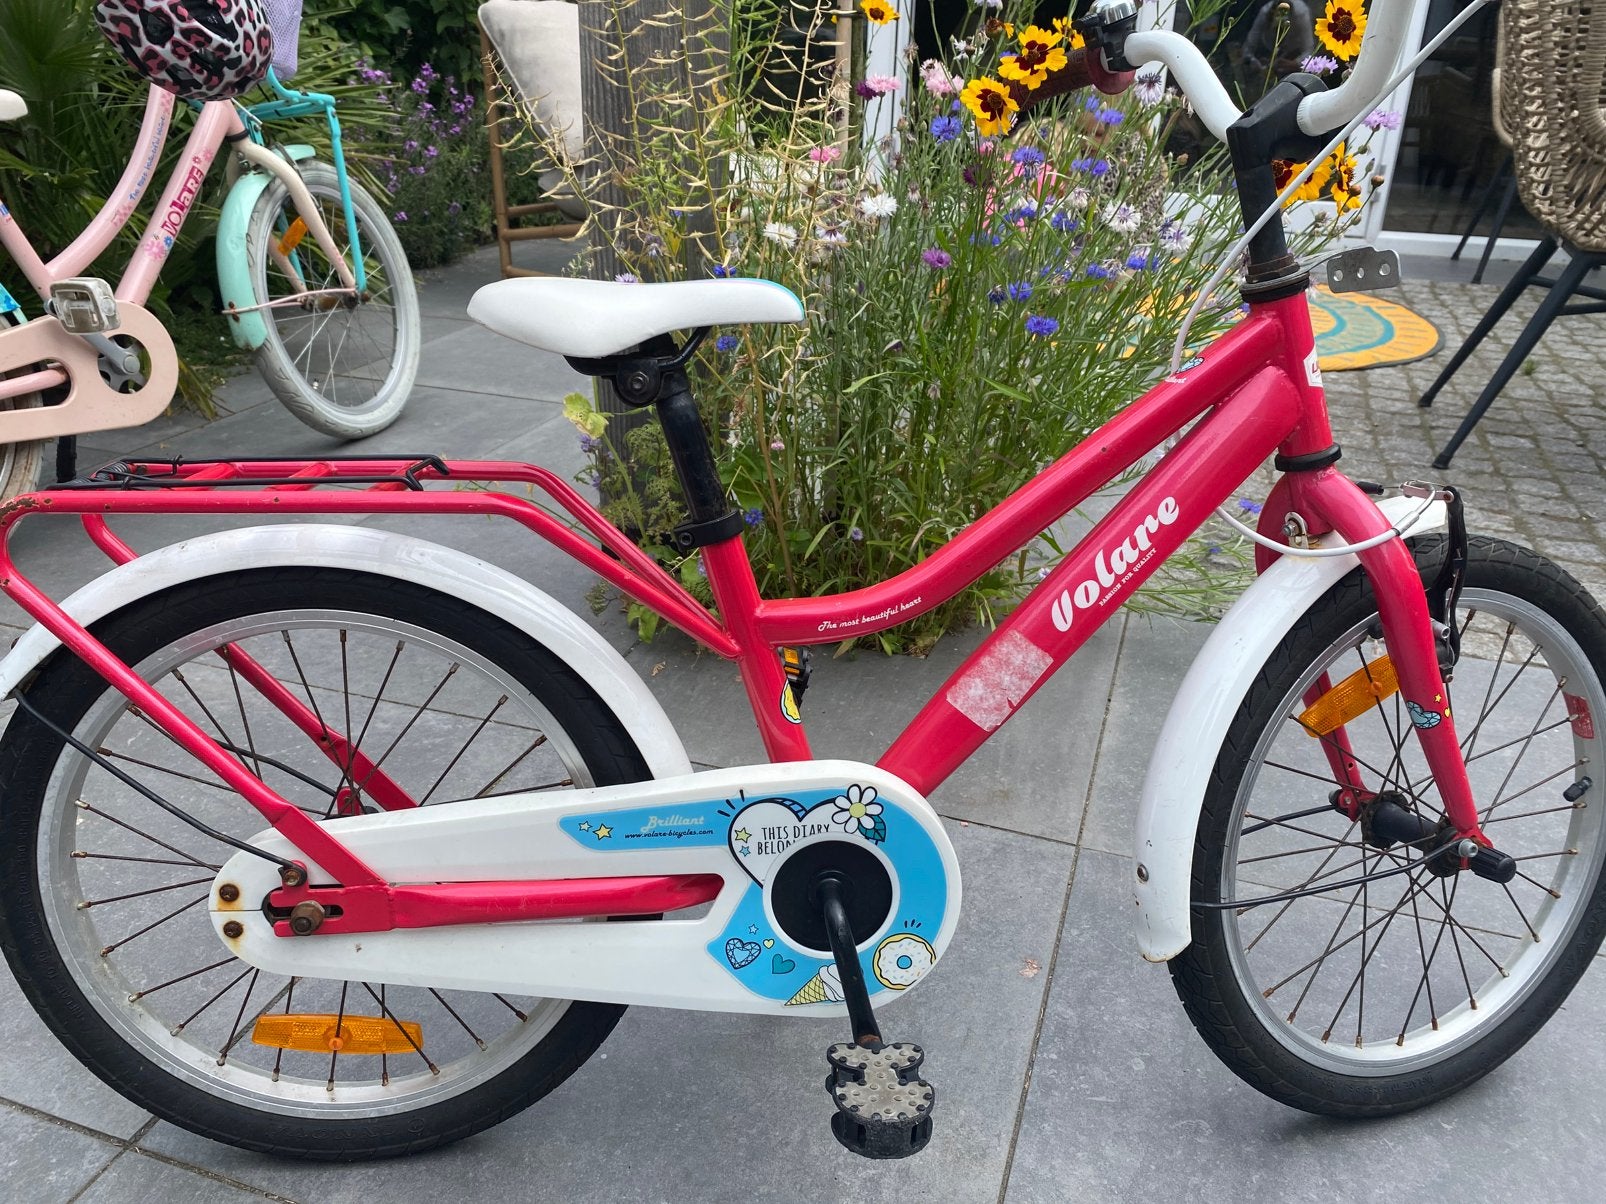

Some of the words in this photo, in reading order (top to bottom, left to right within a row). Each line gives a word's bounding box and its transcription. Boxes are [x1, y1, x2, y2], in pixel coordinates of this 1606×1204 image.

[1051, 496, 1179, 632] Volare
[1121, 571, 1133, 584] FOR
[1133, 547, 1156, 572] QUALITY
[817, 621, 838, 632] The
[839, 618, 860, 628] most
[861, 604, 899, 623] beautiful
[900, 596, 922, 612] heart
[624, 828, 714, 839] www.volare-bicycles.com
[640, 814, 705, 833] Brilliant
[761, 825, 789, 841] THIS
[793, 823, 830, 839] DIARY
